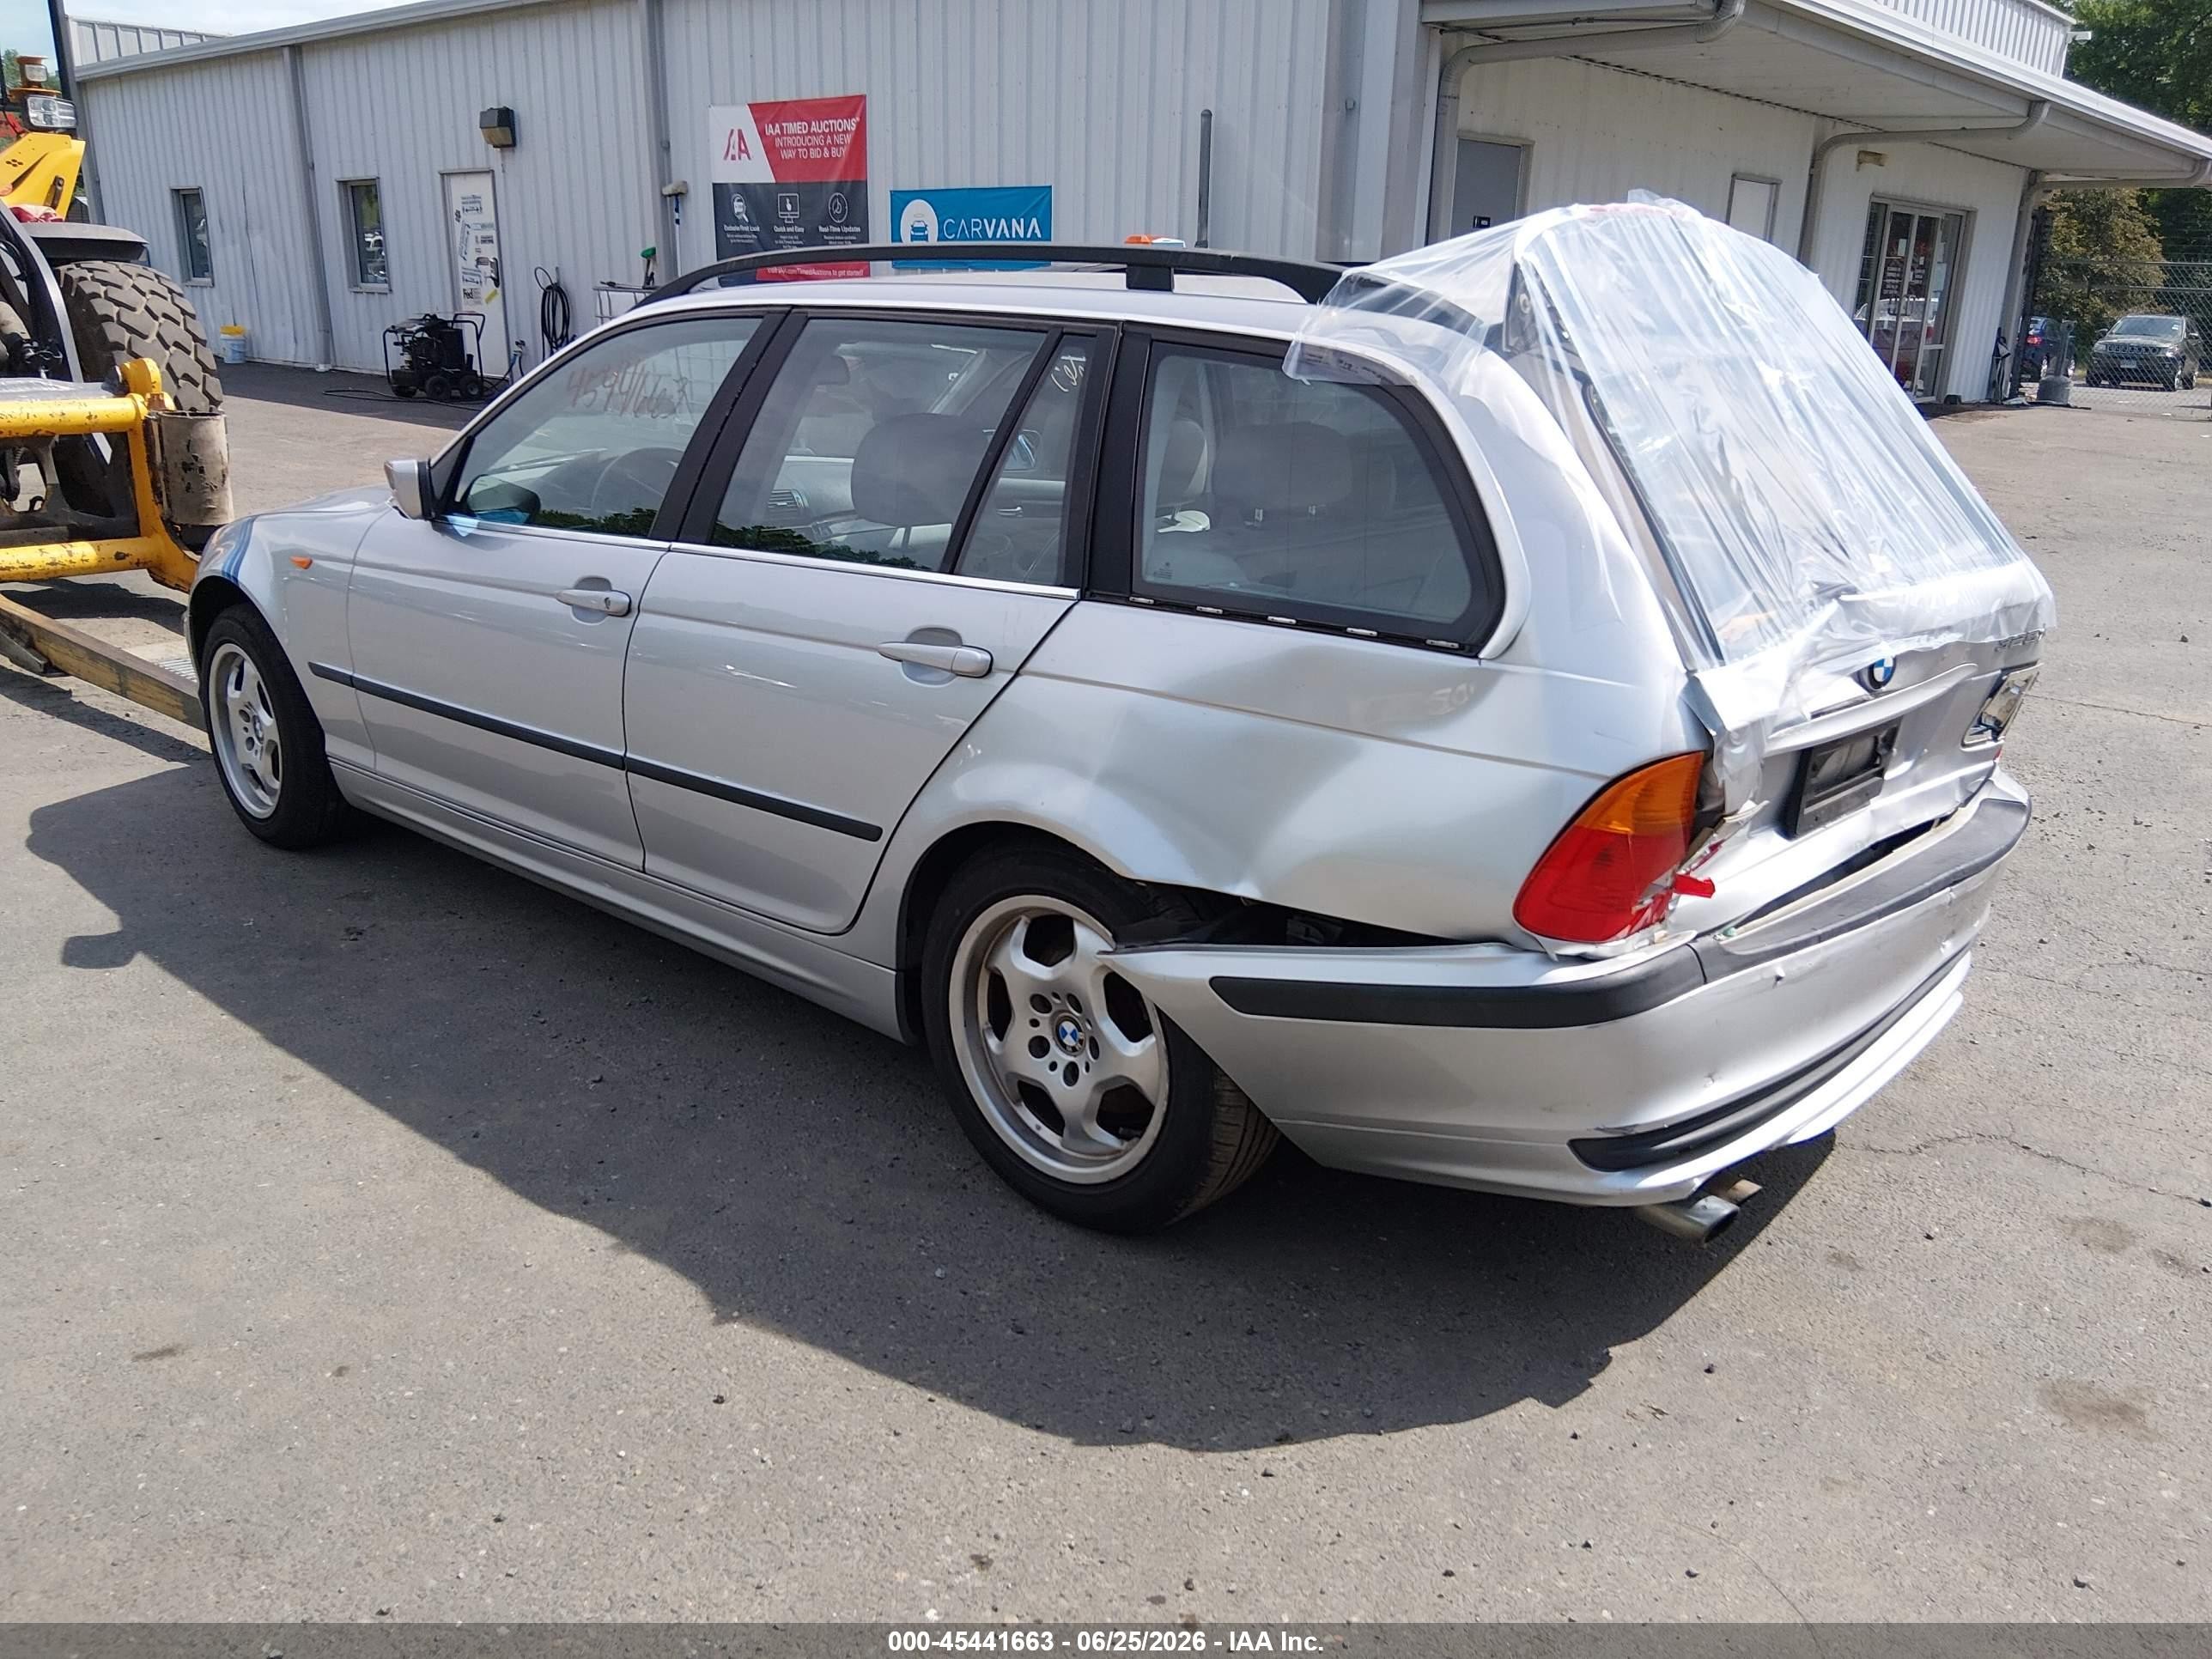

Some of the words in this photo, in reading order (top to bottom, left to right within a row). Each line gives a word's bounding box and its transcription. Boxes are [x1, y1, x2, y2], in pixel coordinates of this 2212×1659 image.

[765, 124, 781, 136] IAA
[782, 122, 808, 135] TIMED
[775, 135, 824, 148] INTRODUCING
[826, 134, 832, 145] A
[833, 133, 852, 144] NEW
[780, 149, 797, 160] WAY
[799, 149, 808, 159] TO
[810, 148, 822, 159] BID
[823, 148, 830, 158] &
[830, 147, 846, 158] BUY
[943, 217, 1042, 240] CARVANA
